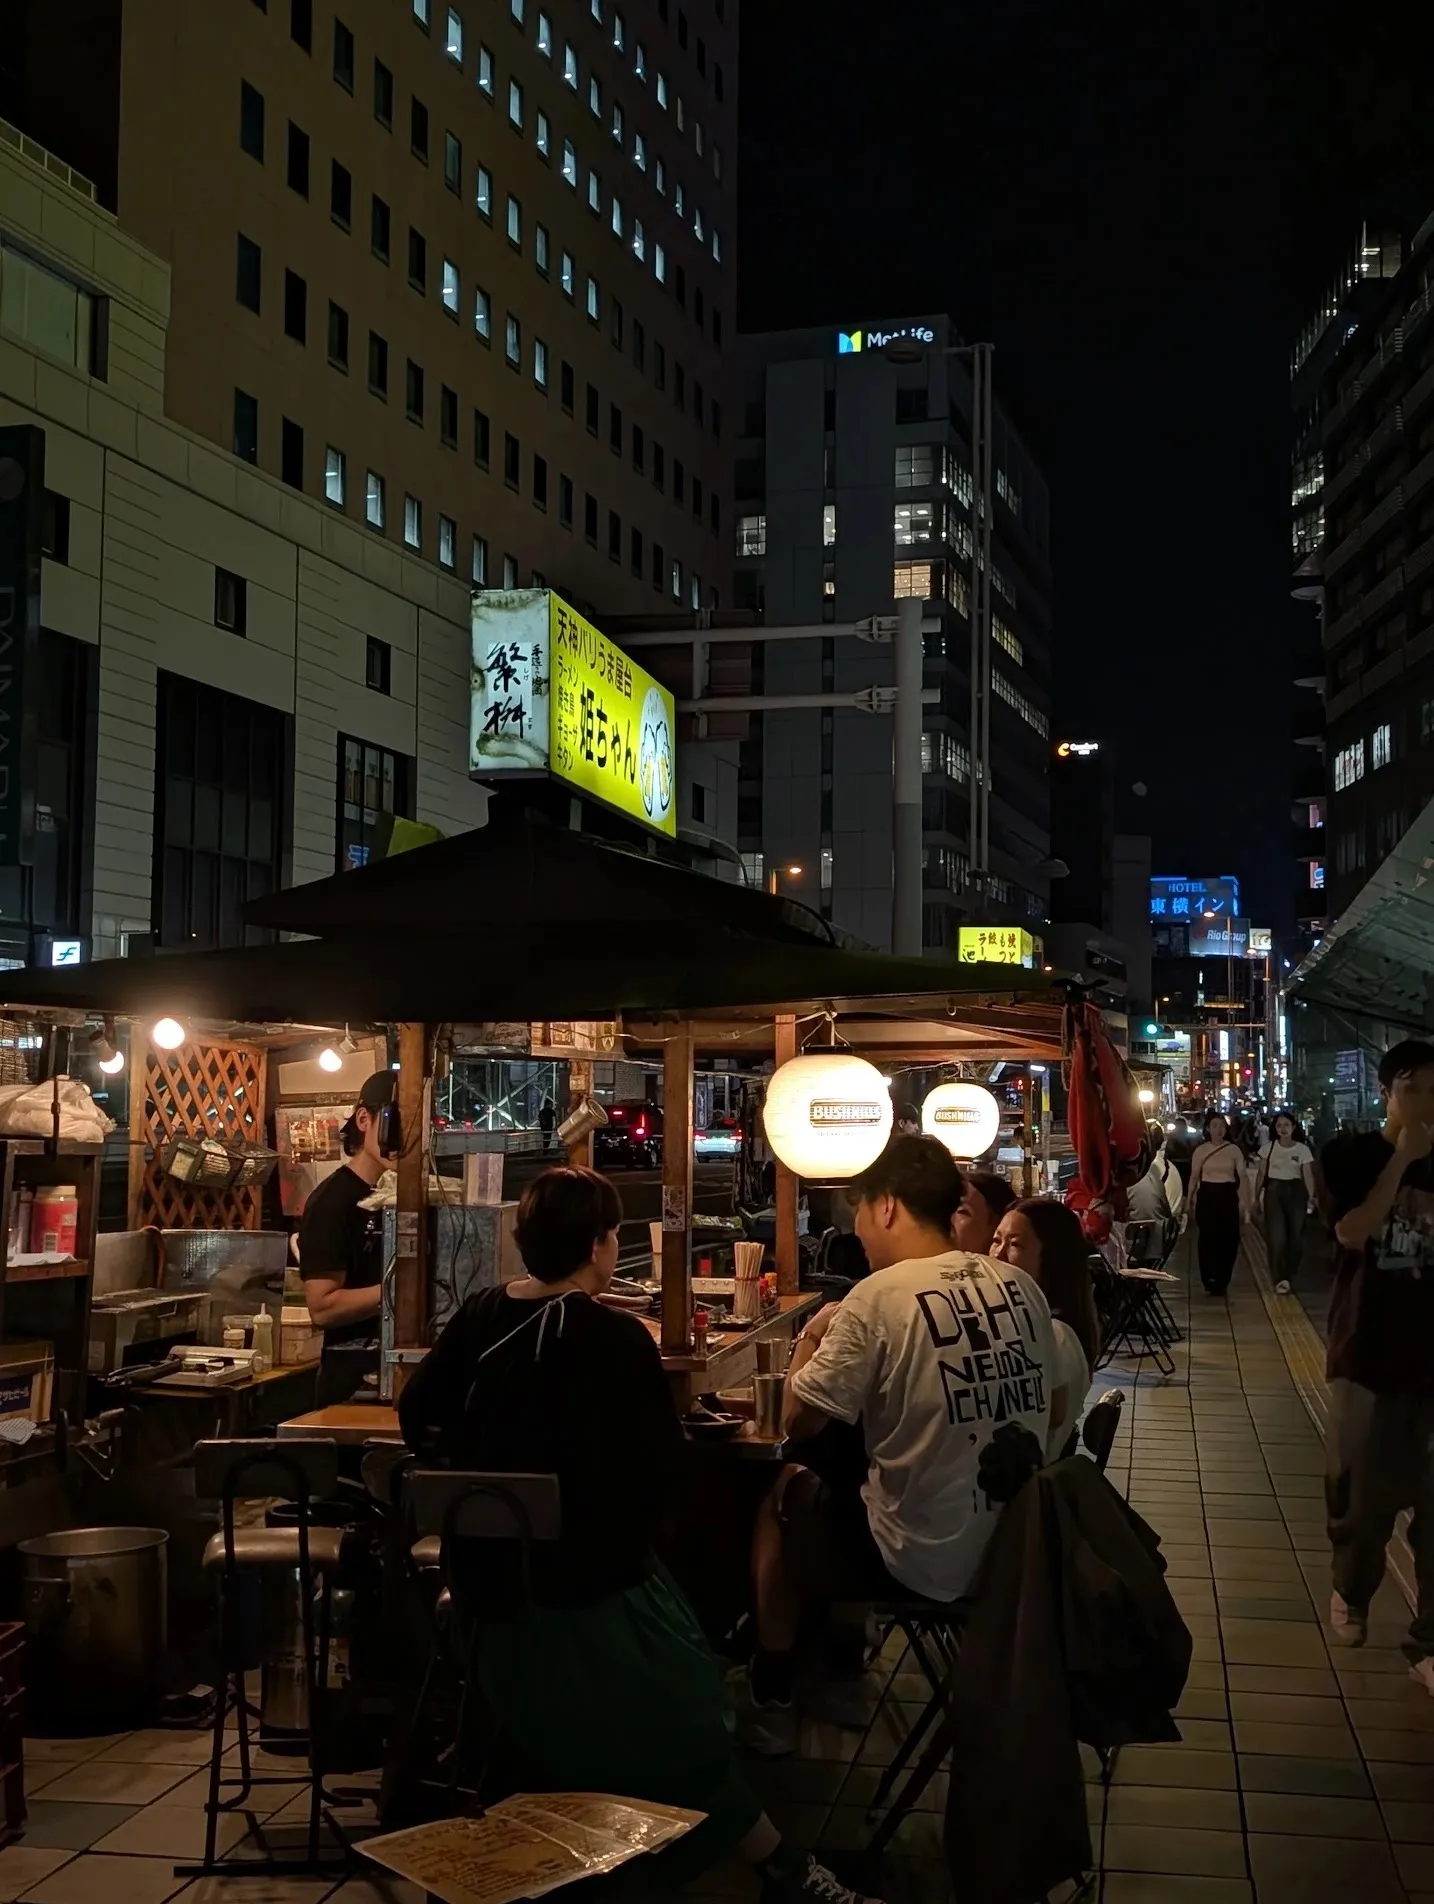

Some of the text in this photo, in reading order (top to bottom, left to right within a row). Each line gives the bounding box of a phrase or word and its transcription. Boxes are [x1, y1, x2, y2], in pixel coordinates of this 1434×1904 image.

[557, 607, 633, 701] 天神バリうま屋台
[557, 655, 578, 687] ラーメン
[580, 682, 636, 785] 姫ちゃん
[1168, 882, 1207, 893] HOTEL
[1151, 897, 1225, 914] 東横イン
[1207, 930, 1221, 941] Rio
